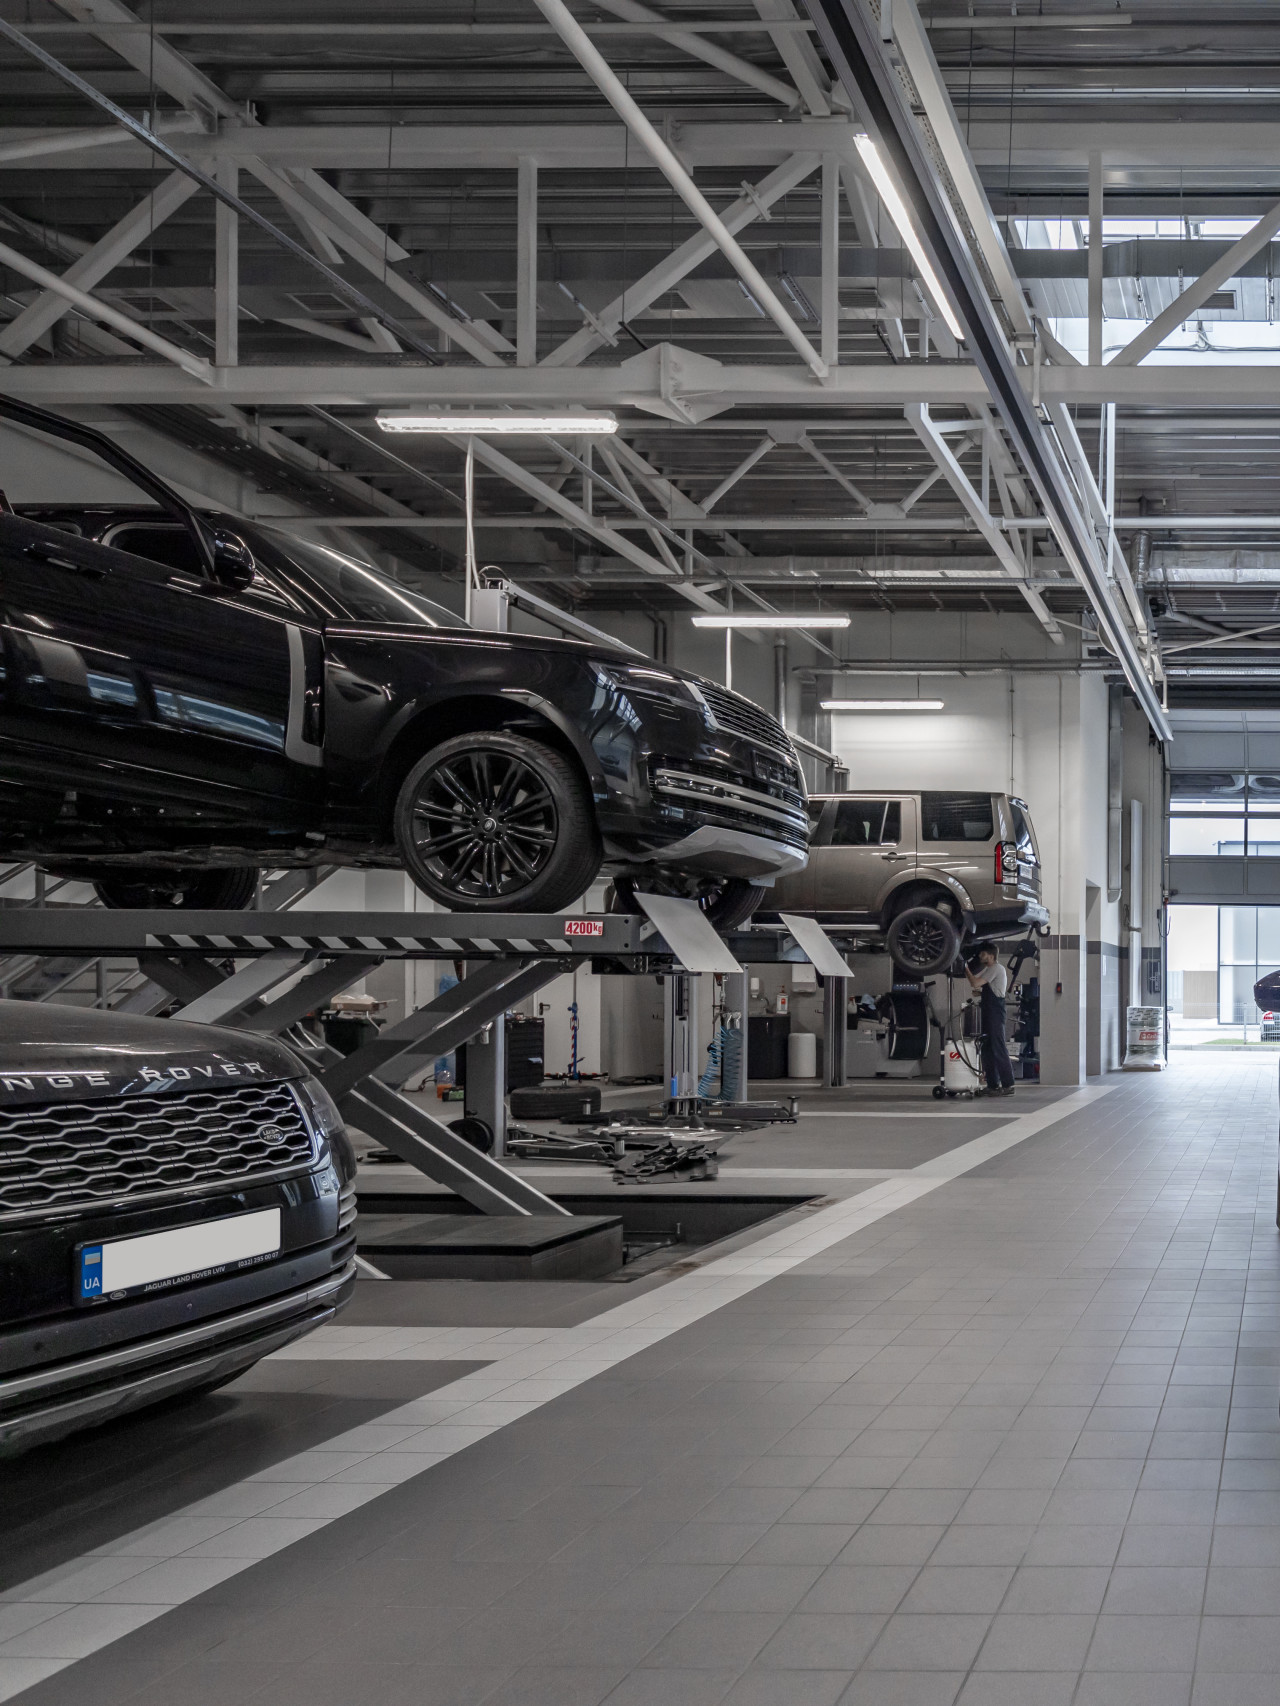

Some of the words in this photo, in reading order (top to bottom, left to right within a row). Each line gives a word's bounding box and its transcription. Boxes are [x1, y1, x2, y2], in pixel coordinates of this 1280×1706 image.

[566, 921, 603, 934] 4200kg
[139, 1062, 265, 1082] ROVER
[144, 1279, 171, 1292] JAGUAR
[173, 1275, 190, 1285] LAND
[191, 1269, 212, 1279] ROVER
[213, 1265, 226, 1274] LVIV
[238, 1259, 253, 1268] (032)
[254, 1255, 264, 1263] 295
[84, 1277, 100, 1290] UA
